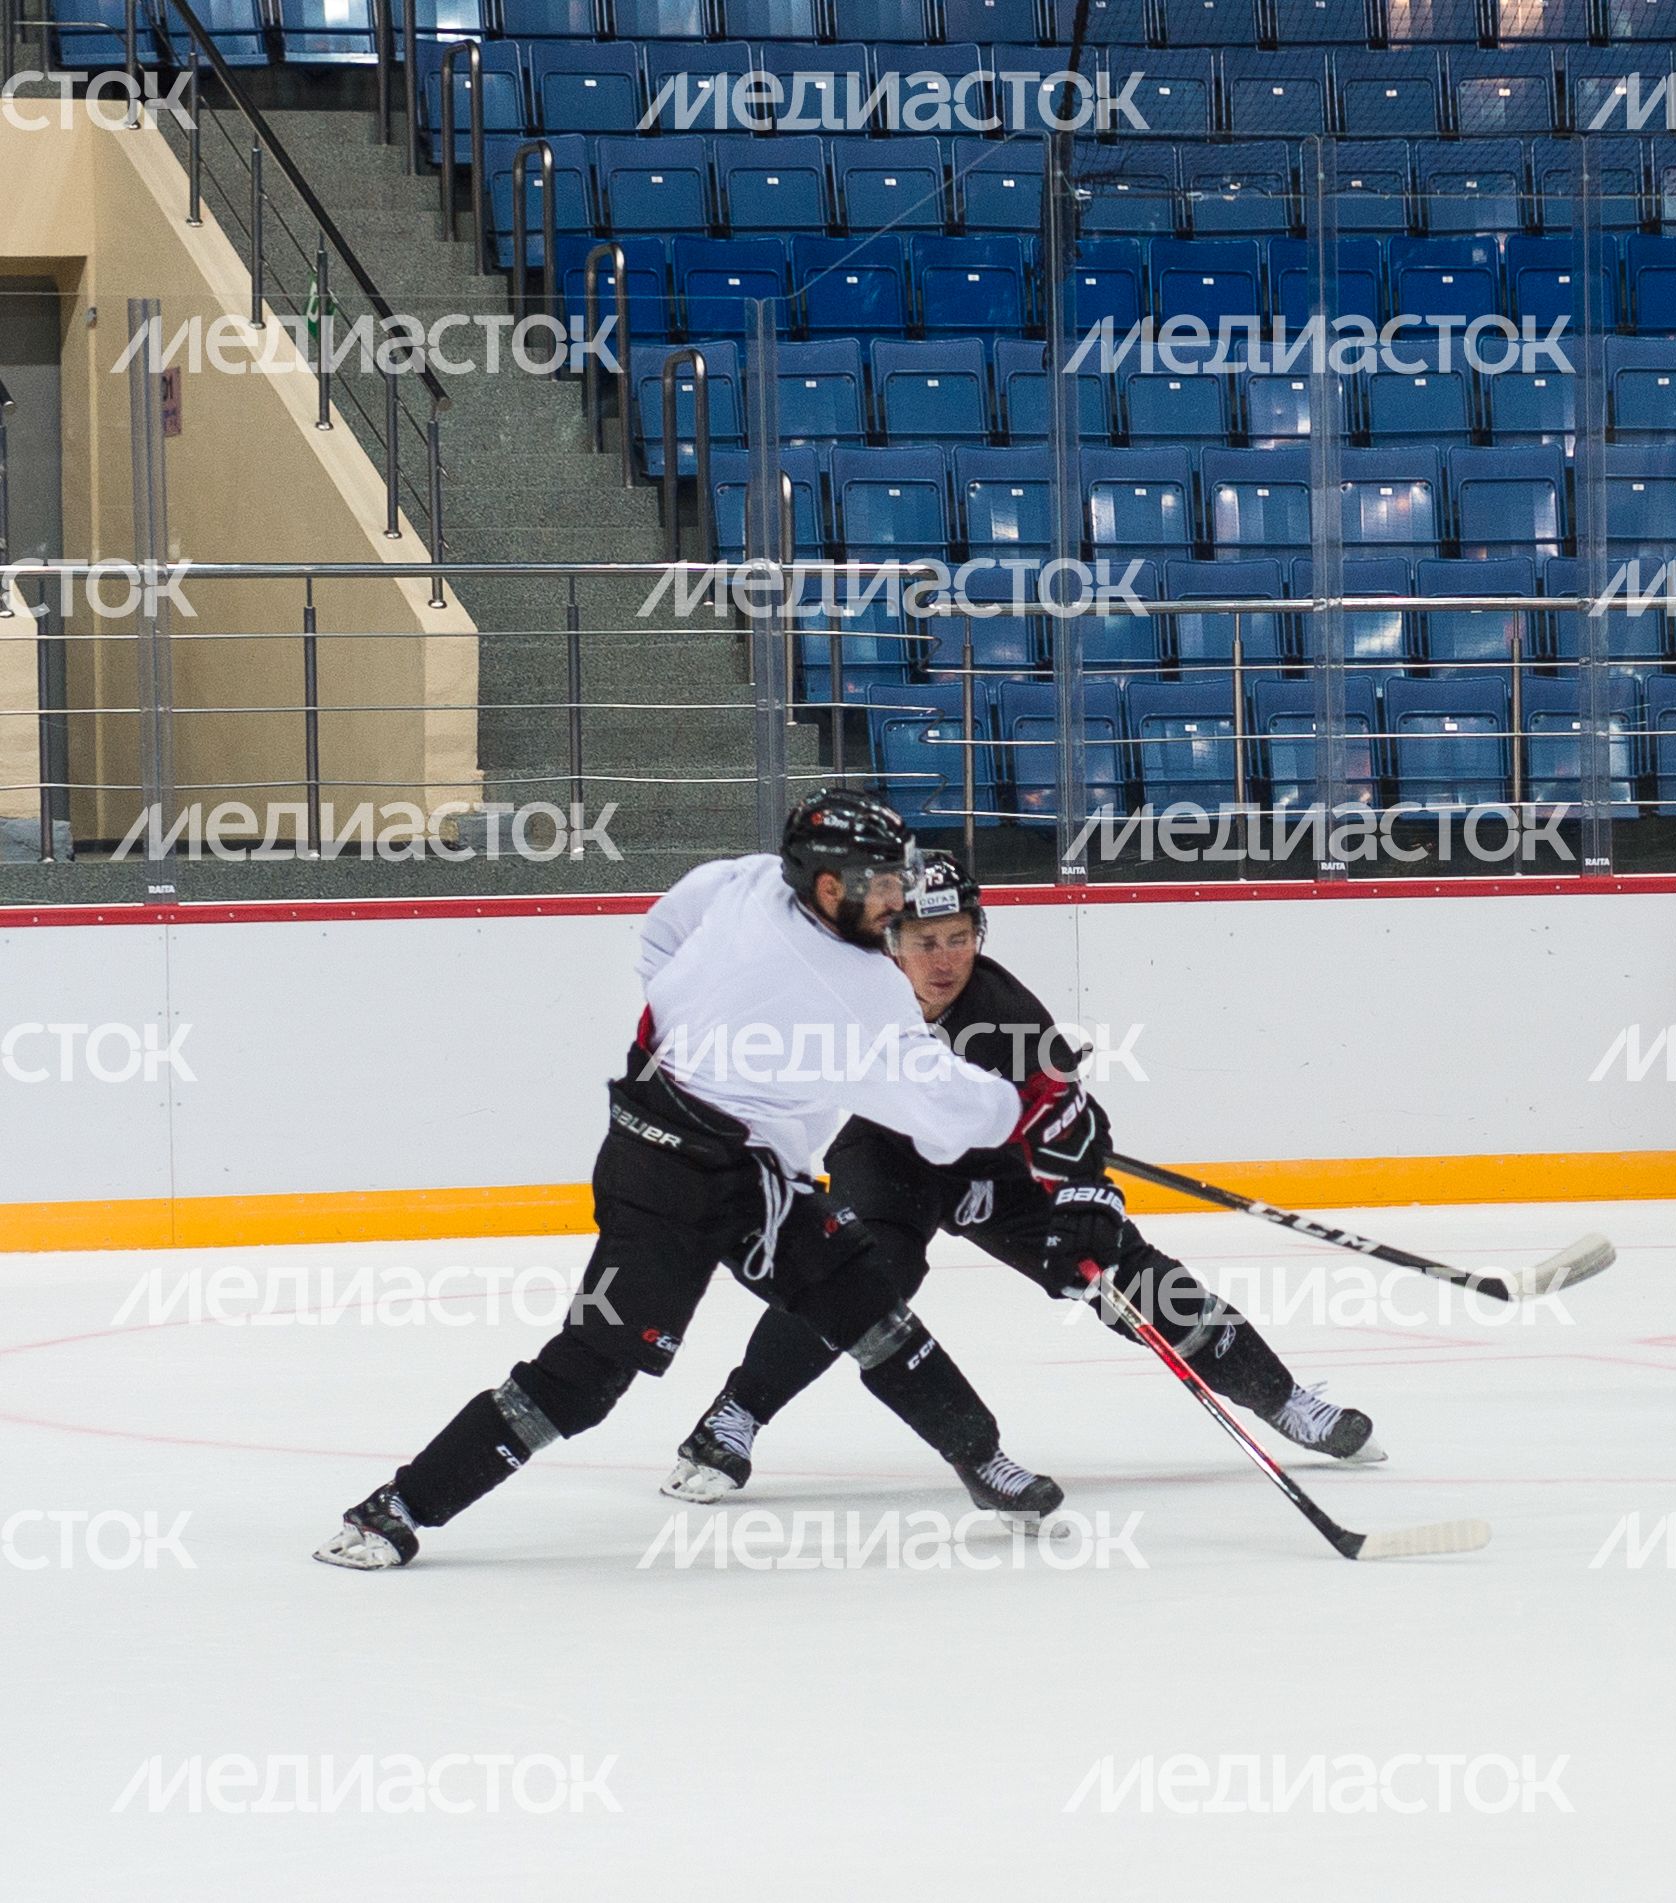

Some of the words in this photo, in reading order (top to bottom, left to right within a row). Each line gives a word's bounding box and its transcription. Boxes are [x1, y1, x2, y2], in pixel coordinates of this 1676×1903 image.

[1320, 861, 1346, 871] RAITA
[1585, 857, 1610, 867] RAITA
[1061, 866, 1086, 876] RAITA
[148, 884, 175, 895] RAITA
[1248, 1201, 1380, 1254] CCM
